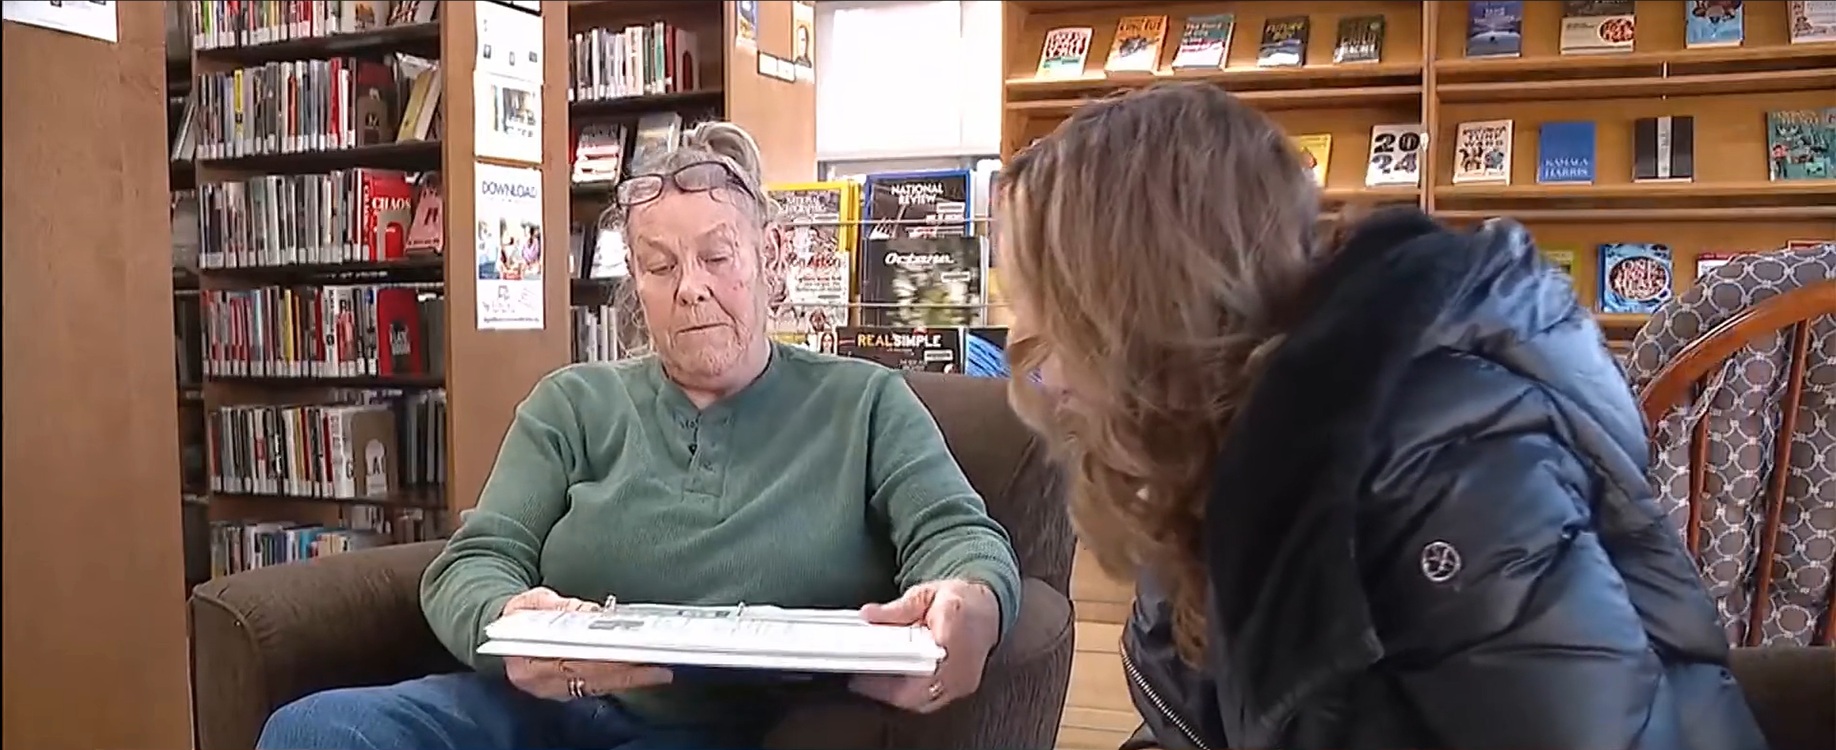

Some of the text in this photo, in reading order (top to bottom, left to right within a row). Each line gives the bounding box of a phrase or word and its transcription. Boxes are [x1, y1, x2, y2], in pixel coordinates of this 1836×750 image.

[1374, 132, 1420, 152] 20
[1372, 153, 1417, 174] 24
[1544, 157, 1589, 167] KAMALA
[1544, 167, 1588, 179] HARRIS
[891, 183, 944, 196] NATIONAL
[371, 197, 412, 211] CHAOS
[898, 193, 937, 205] REVIEW
